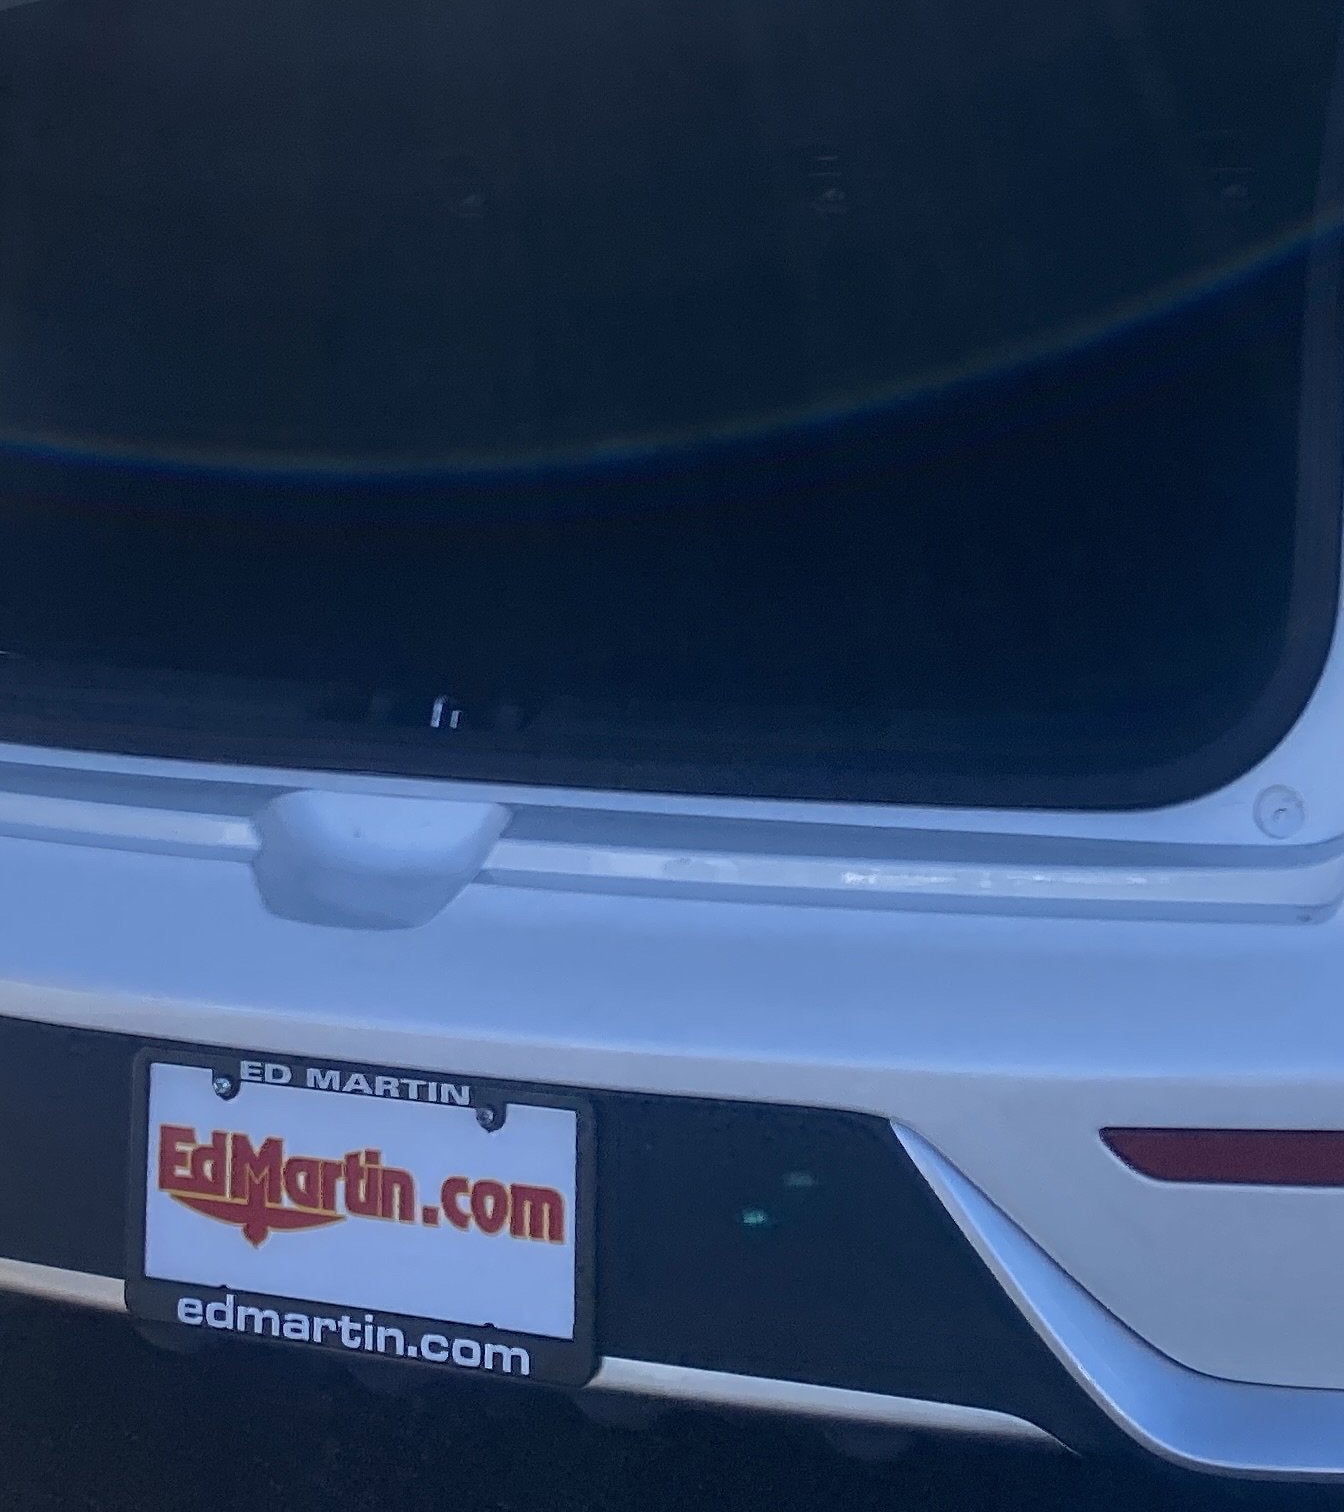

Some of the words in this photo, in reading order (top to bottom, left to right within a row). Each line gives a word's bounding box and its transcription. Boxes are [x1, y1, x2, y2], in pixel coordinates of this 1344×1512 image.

[240, 1060, 292, 1085] ED
[306, 1067, 471, 1106] MARTIN
[159, 1124, 565, 1245] EdMartin.com
[177, 1294, 530, 1376] edmartin.com
